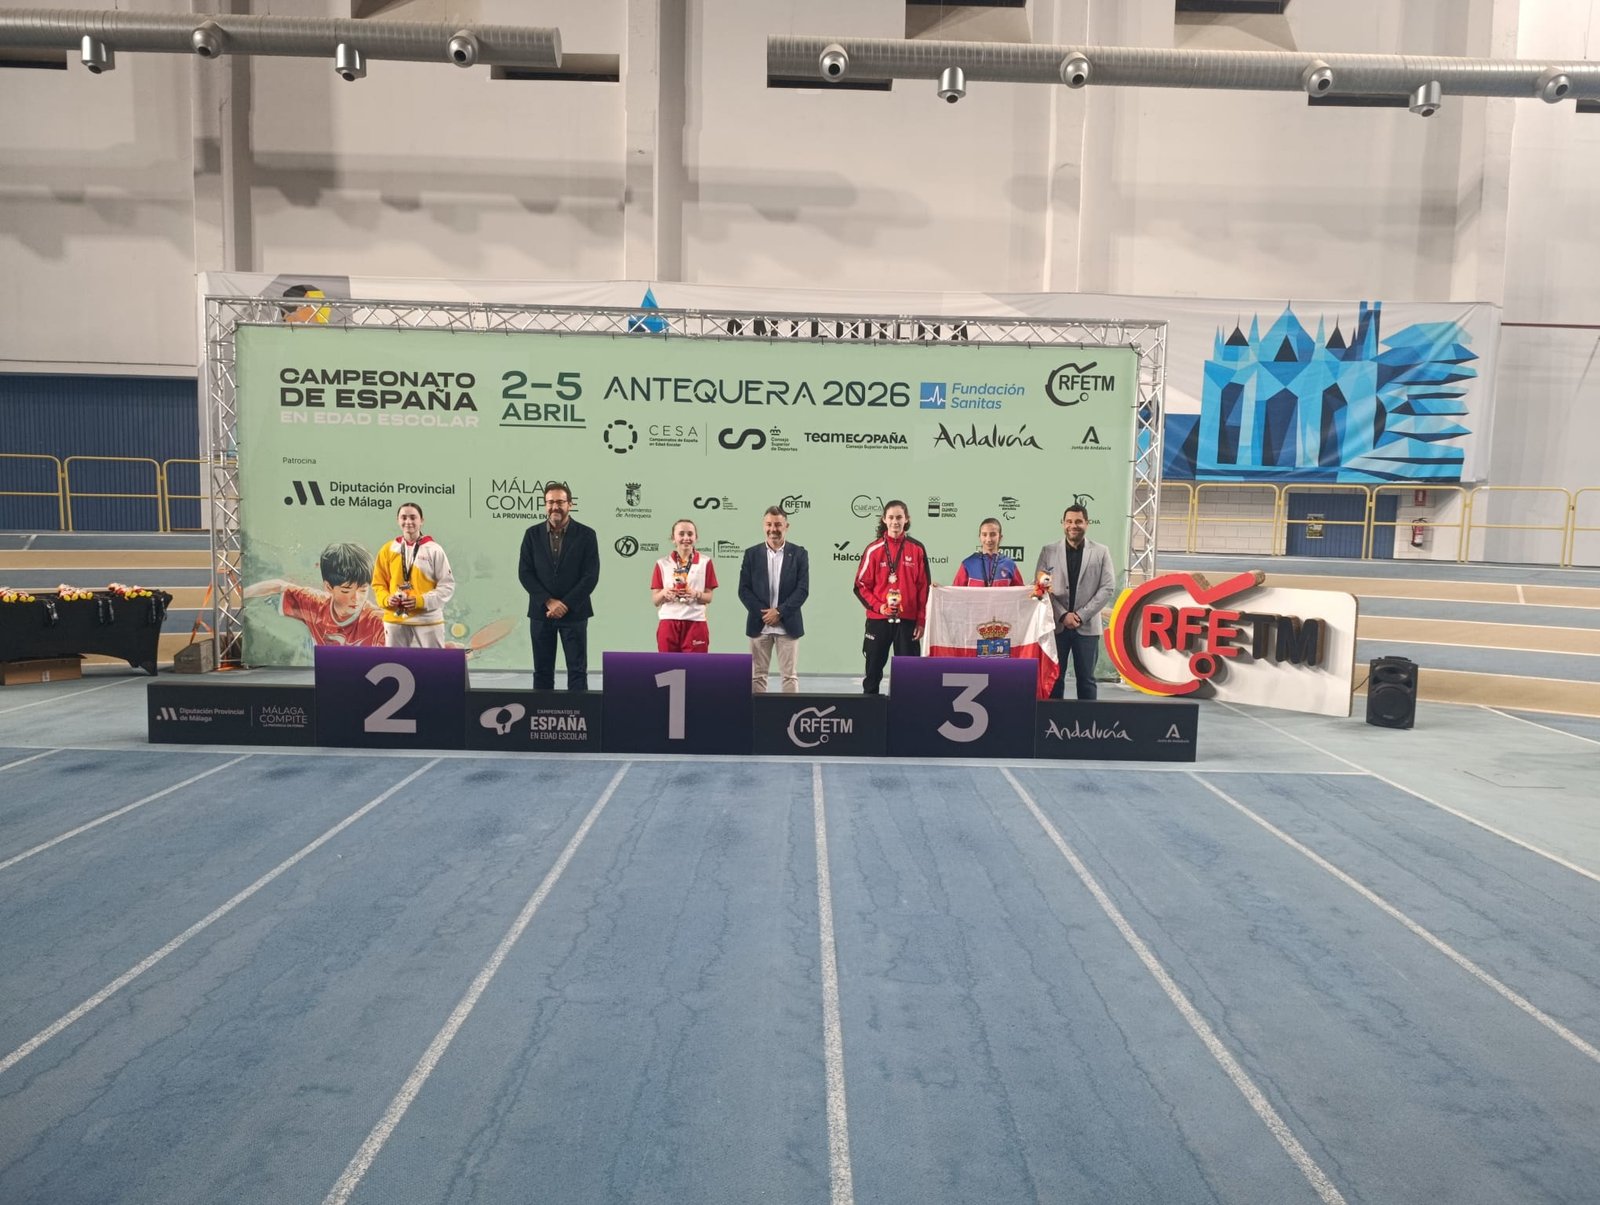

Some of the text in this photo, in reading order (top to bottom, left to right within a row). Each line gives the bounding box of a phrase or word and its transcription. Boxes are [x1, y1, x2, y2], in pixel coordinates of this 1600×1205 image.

[279, 367, 476, 389] CAMPEONATO
[1058, 375, 1115, 392] RFETM
[603, 376, 911, 407] ANTEQUERA 2026
[951, 382, 1026, 397] Fundación
[280, 387, 478, 412] DE ESPAÑA
[950, 397, 1003, 411] Sanitas
[280, 411, 480, 428] EN EDAD ESCOLAR
[501, 402, 586, 423] ABRIL
[648, 424, 699, 437] CESA
[934, 422, 1044, 451] Andalucía
[329, 481, 455, 496] Diputación Provincial
[491, 477, 570, 494] MÁLAA
[329, 497, 392, 508] de Málaga
[486, 495, 579, 512] COMPE
[784, 501, 811, 509] RFETM
[833, 553, 863, 561] Halcó
[1141, 604, 1326, 666] RFETM
[363, 662, 417, 733] 2
[654, 669, 686, 739] 1
[179, 707, 213, 715] Diputación
[262, 705, 304, 714] MÁLAGA
[937, 673, 990, 742] 3
[259, 714, 308, 724] COMPITE
[530, 715, 587, 731] ESPAÑA
[800, 718, 852, 734] RFETM
[540, 732, 557, 740] EDAD
[559, 732, 587, 740] ESCOLAR
[1045, 719, 1133, 741] Andalucía
